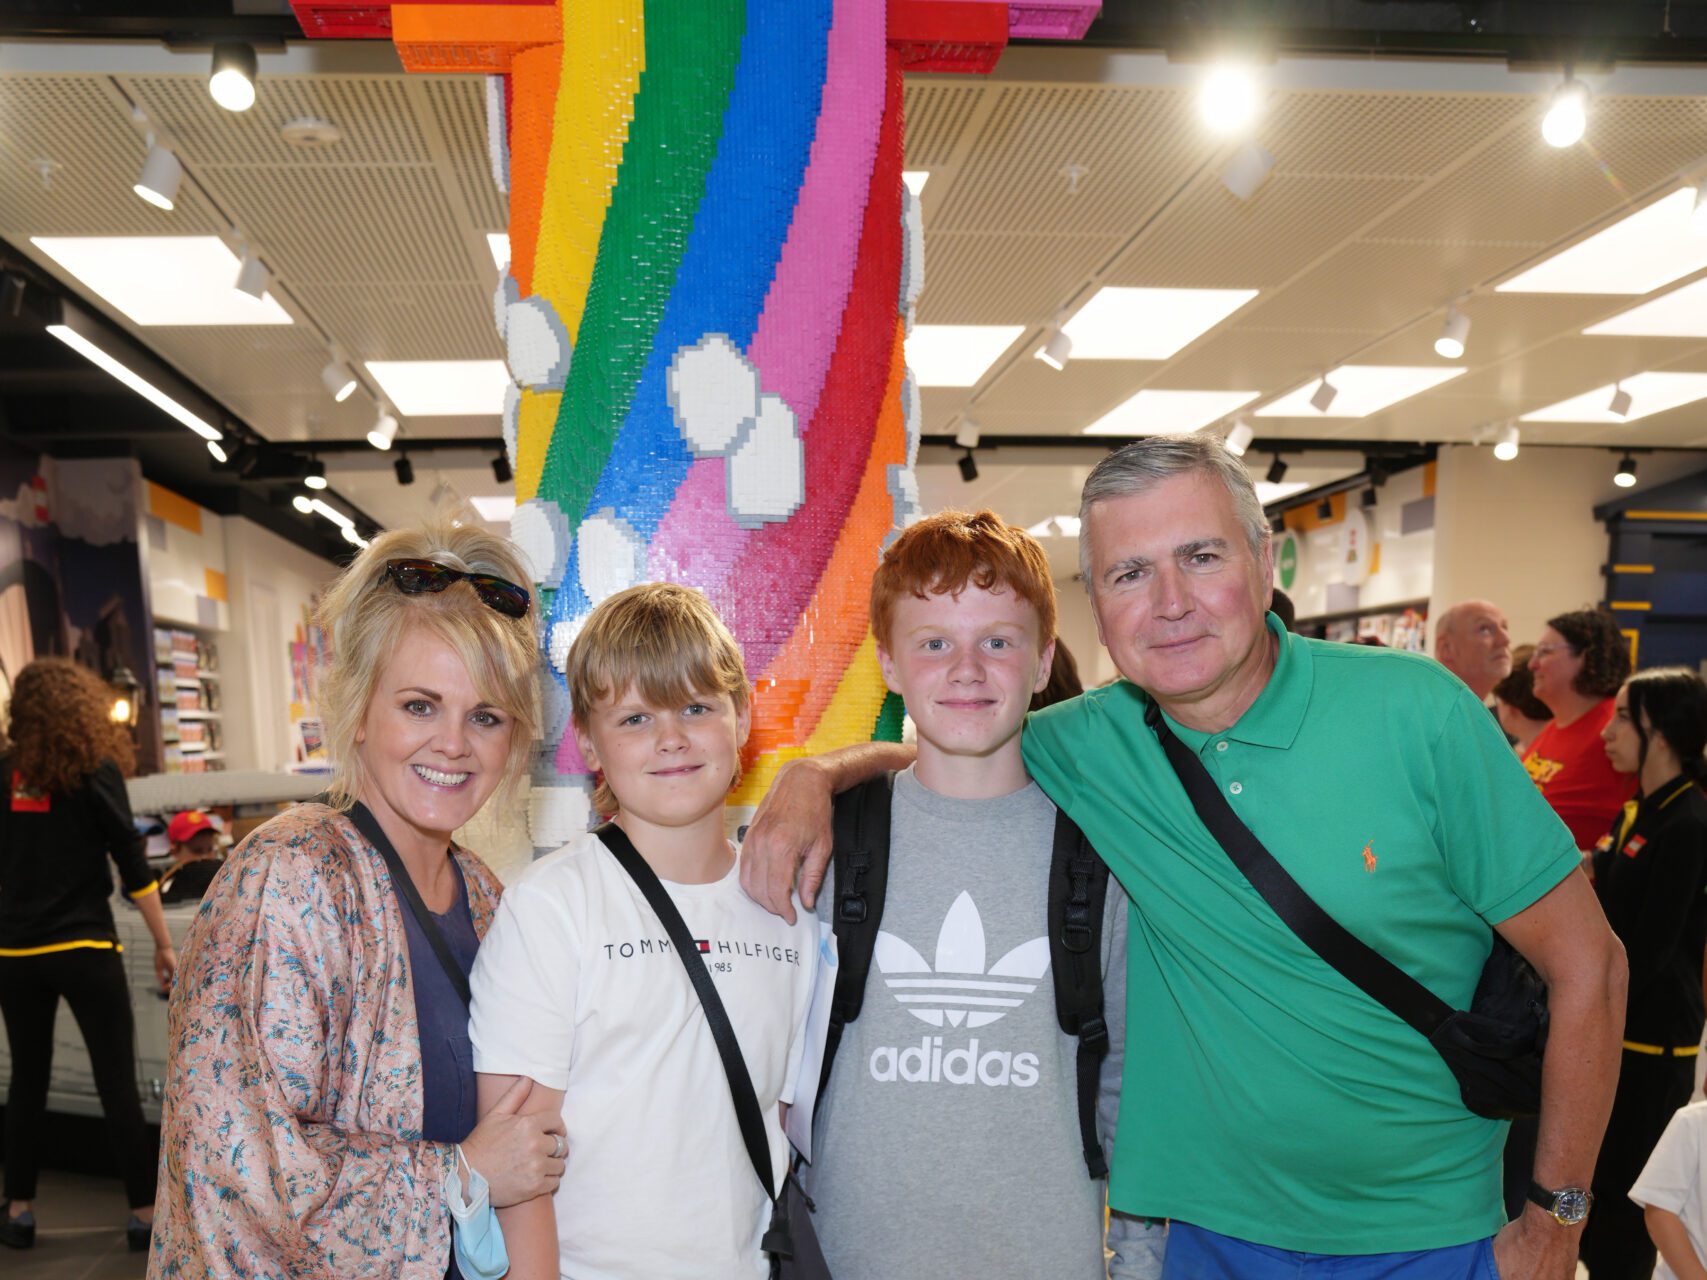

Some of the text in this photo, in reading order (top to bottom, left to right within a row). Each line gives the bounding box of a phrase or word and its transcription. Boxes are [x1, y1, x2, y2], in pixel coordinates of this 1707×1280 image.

[604, 939, 800, 966] TOMM HILFIGER
[708, 962, 733, 973] 1985
[869, 1036, 1040, 1088] adidas
